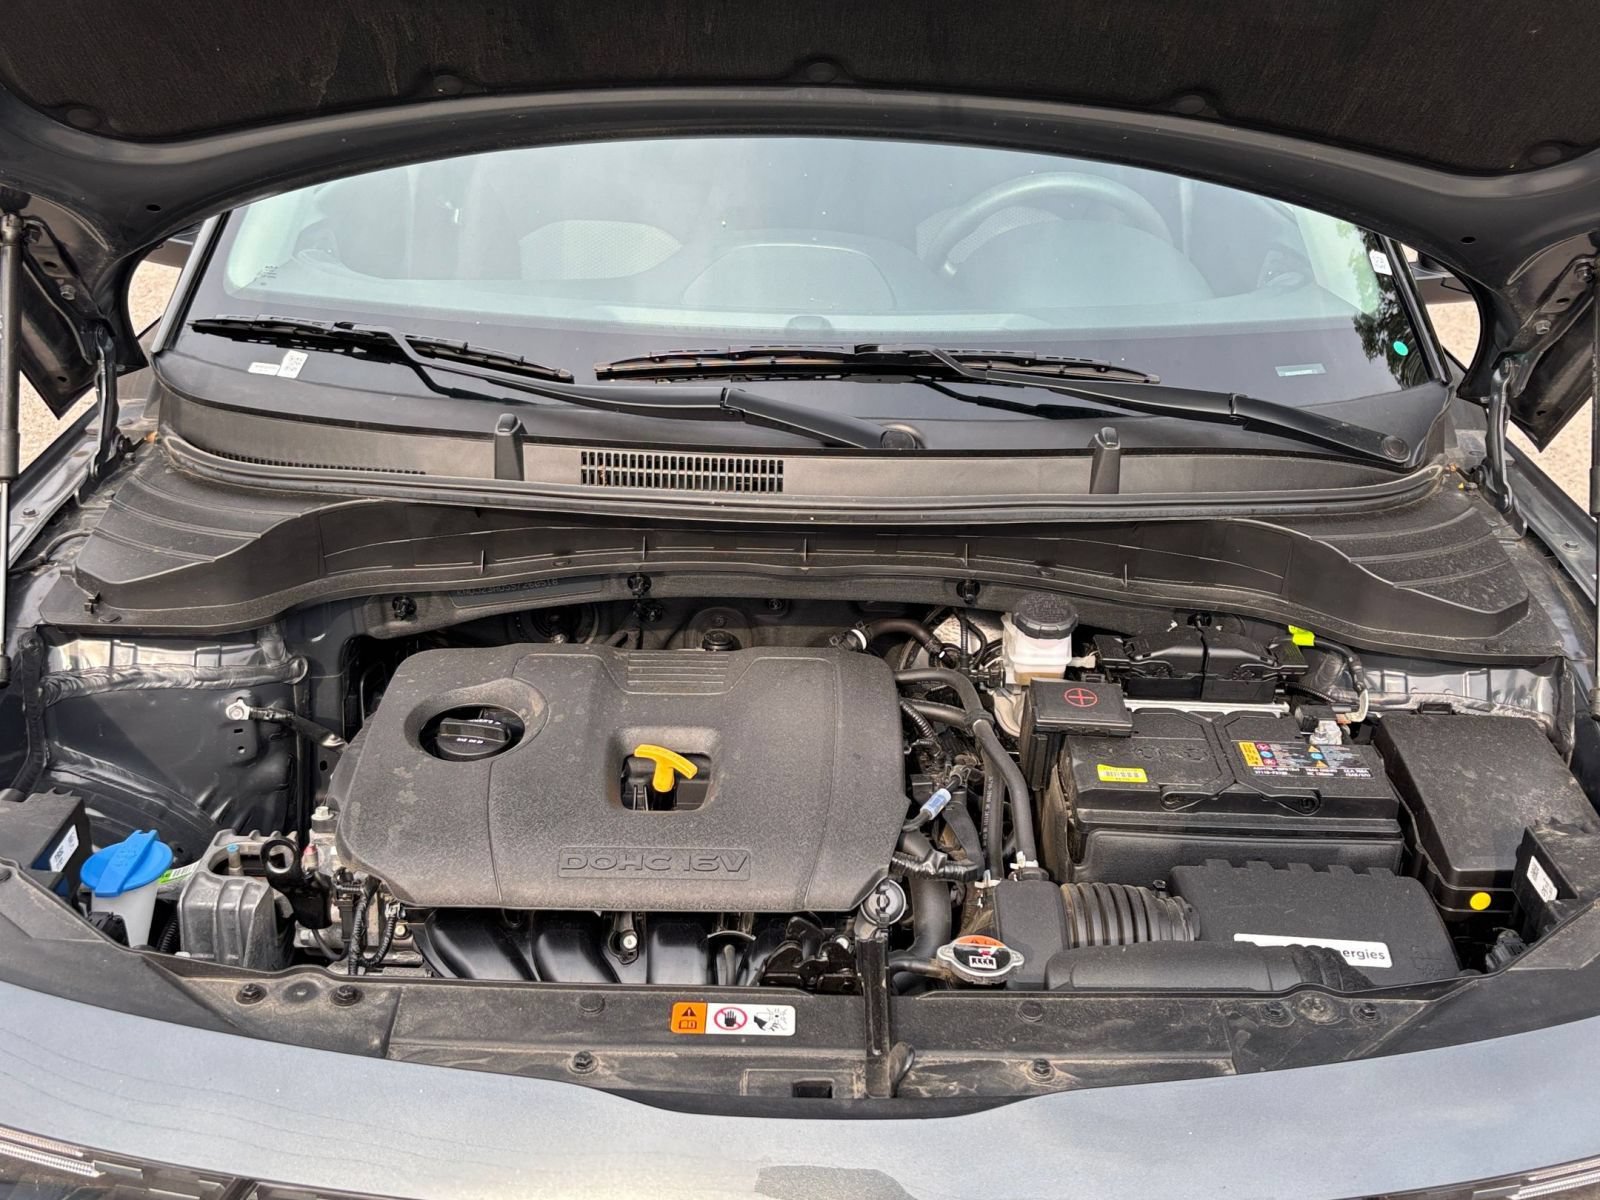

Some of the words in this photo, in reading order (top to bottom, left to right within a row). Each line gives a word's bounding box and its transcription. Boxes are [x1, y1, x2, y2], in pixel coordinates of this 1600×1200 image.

[561, 853, 672, 871] DOHC
[683, 855, 748, 872] 16V
[1342, 949, 1385, 960] ergies
